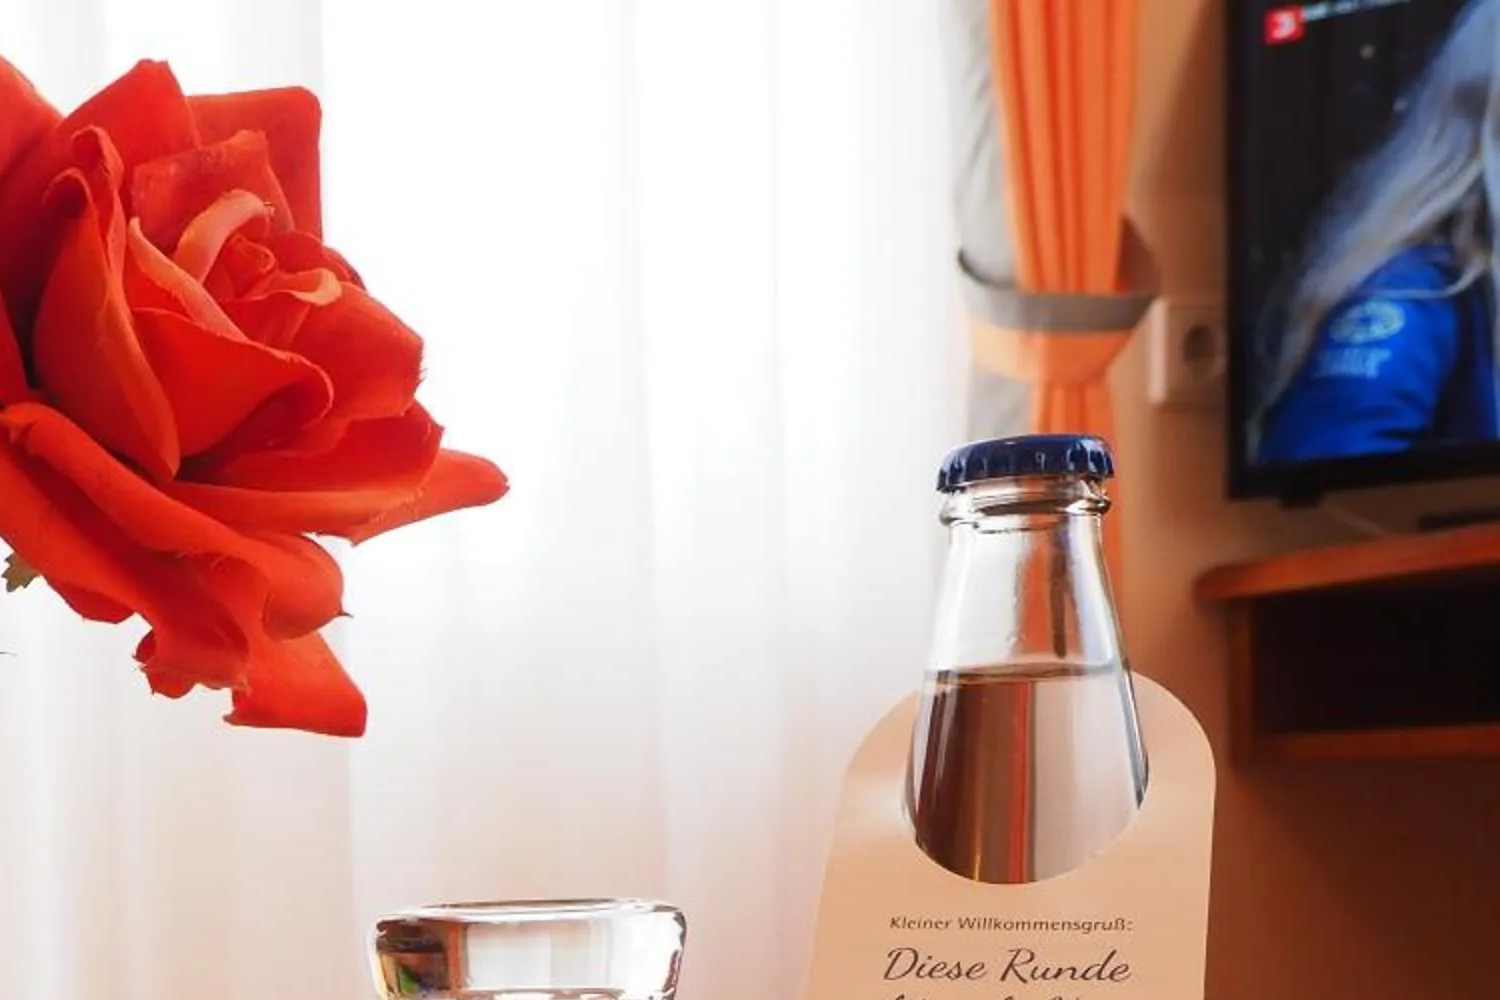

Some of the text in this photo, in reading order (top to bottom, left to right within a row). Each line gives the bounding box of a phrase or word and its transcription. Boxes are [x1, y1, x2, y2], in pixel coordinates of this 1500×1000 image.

[889, 916, 1133, 935] Kleiner Willkommensgruß:
[883, 947, 1132, 984] Diese Runde
